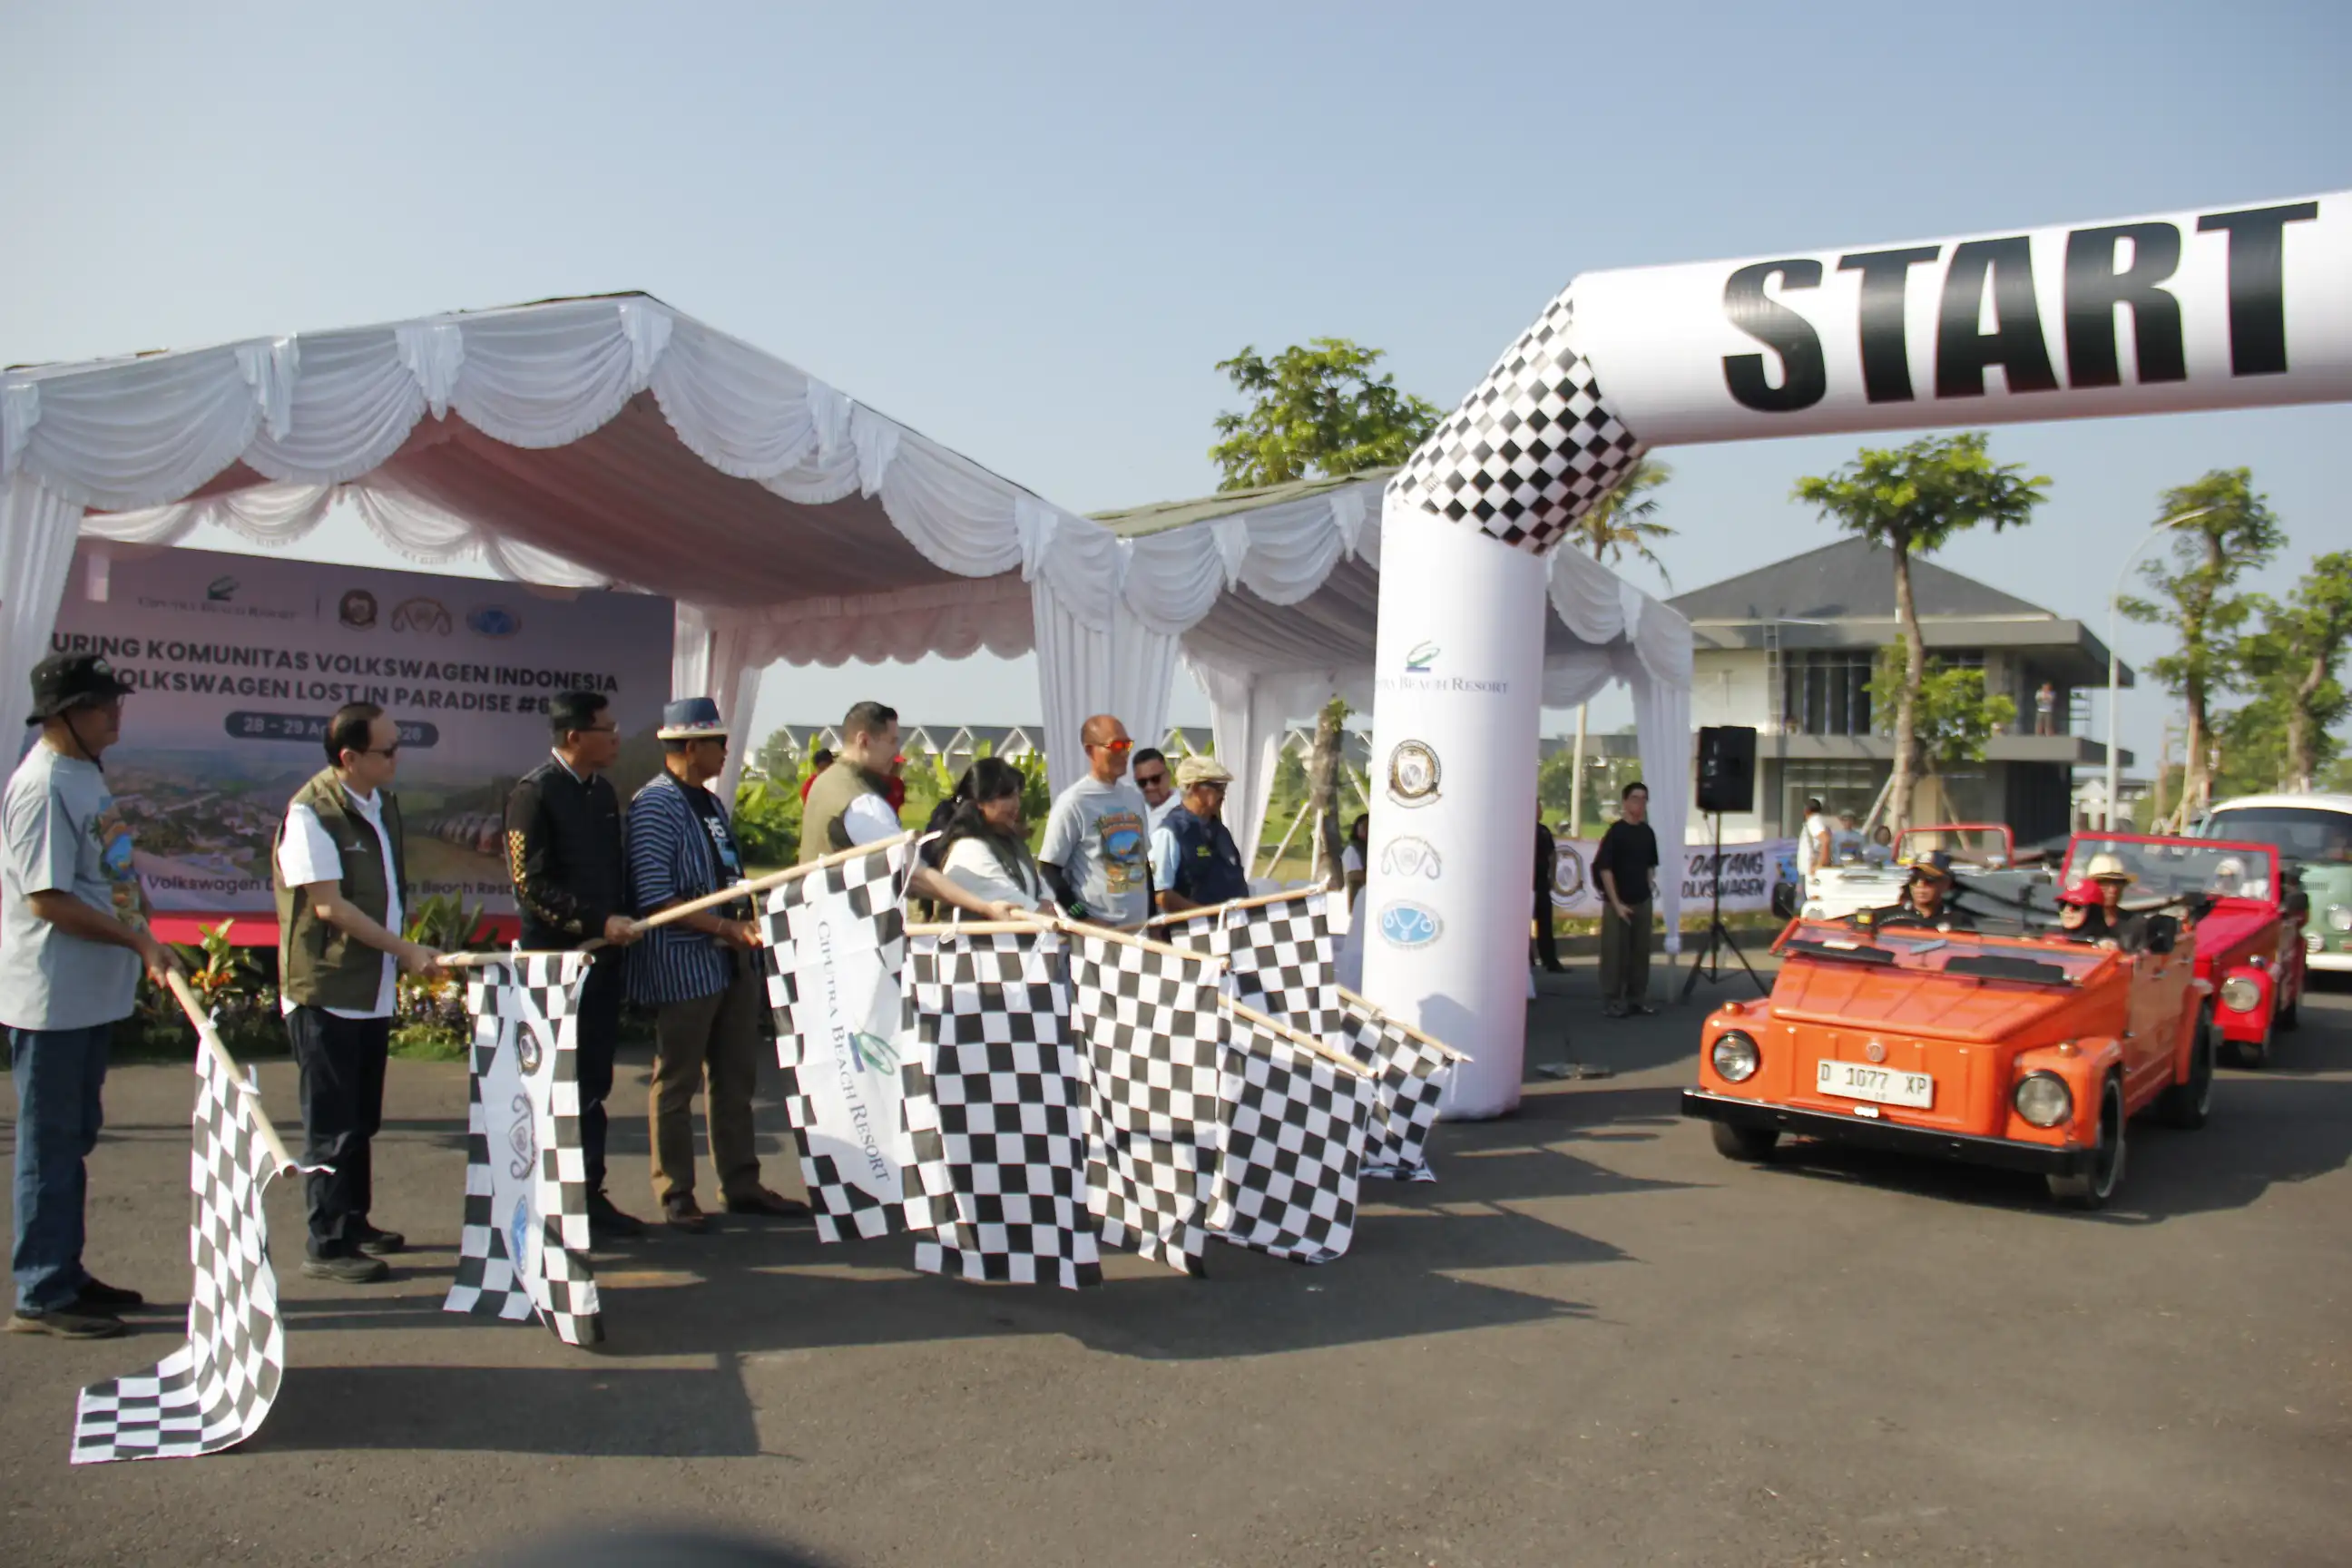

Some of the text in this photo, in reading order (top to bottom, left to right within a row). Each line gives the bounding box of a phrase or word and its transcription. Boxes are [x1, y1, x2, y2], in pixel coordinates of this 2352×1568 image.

[1720, 201, 2319, 414] START
[53, 633, 619, 693] URING KOMUNITAS VOLKSWAGEN INDONESIA
[297, 681, 358, 704] LOST
[364, 686, 387, 705] IN
[394, 687, 512, 713] PARADISE
[1452, 677, 1508, 694] RESORT
[147, 875, 260, 895] Volkswagen
[1681, 878, 1767, 899] OLKSWAGEN
[818, 920, 891, 1181] CIPUTRA BEACH RESORT
[1820, 1063, 1831, 1082] D
[1846, 1068, 1888, 1090] 1077
[1906, 1075, 1927, 1095] XP
